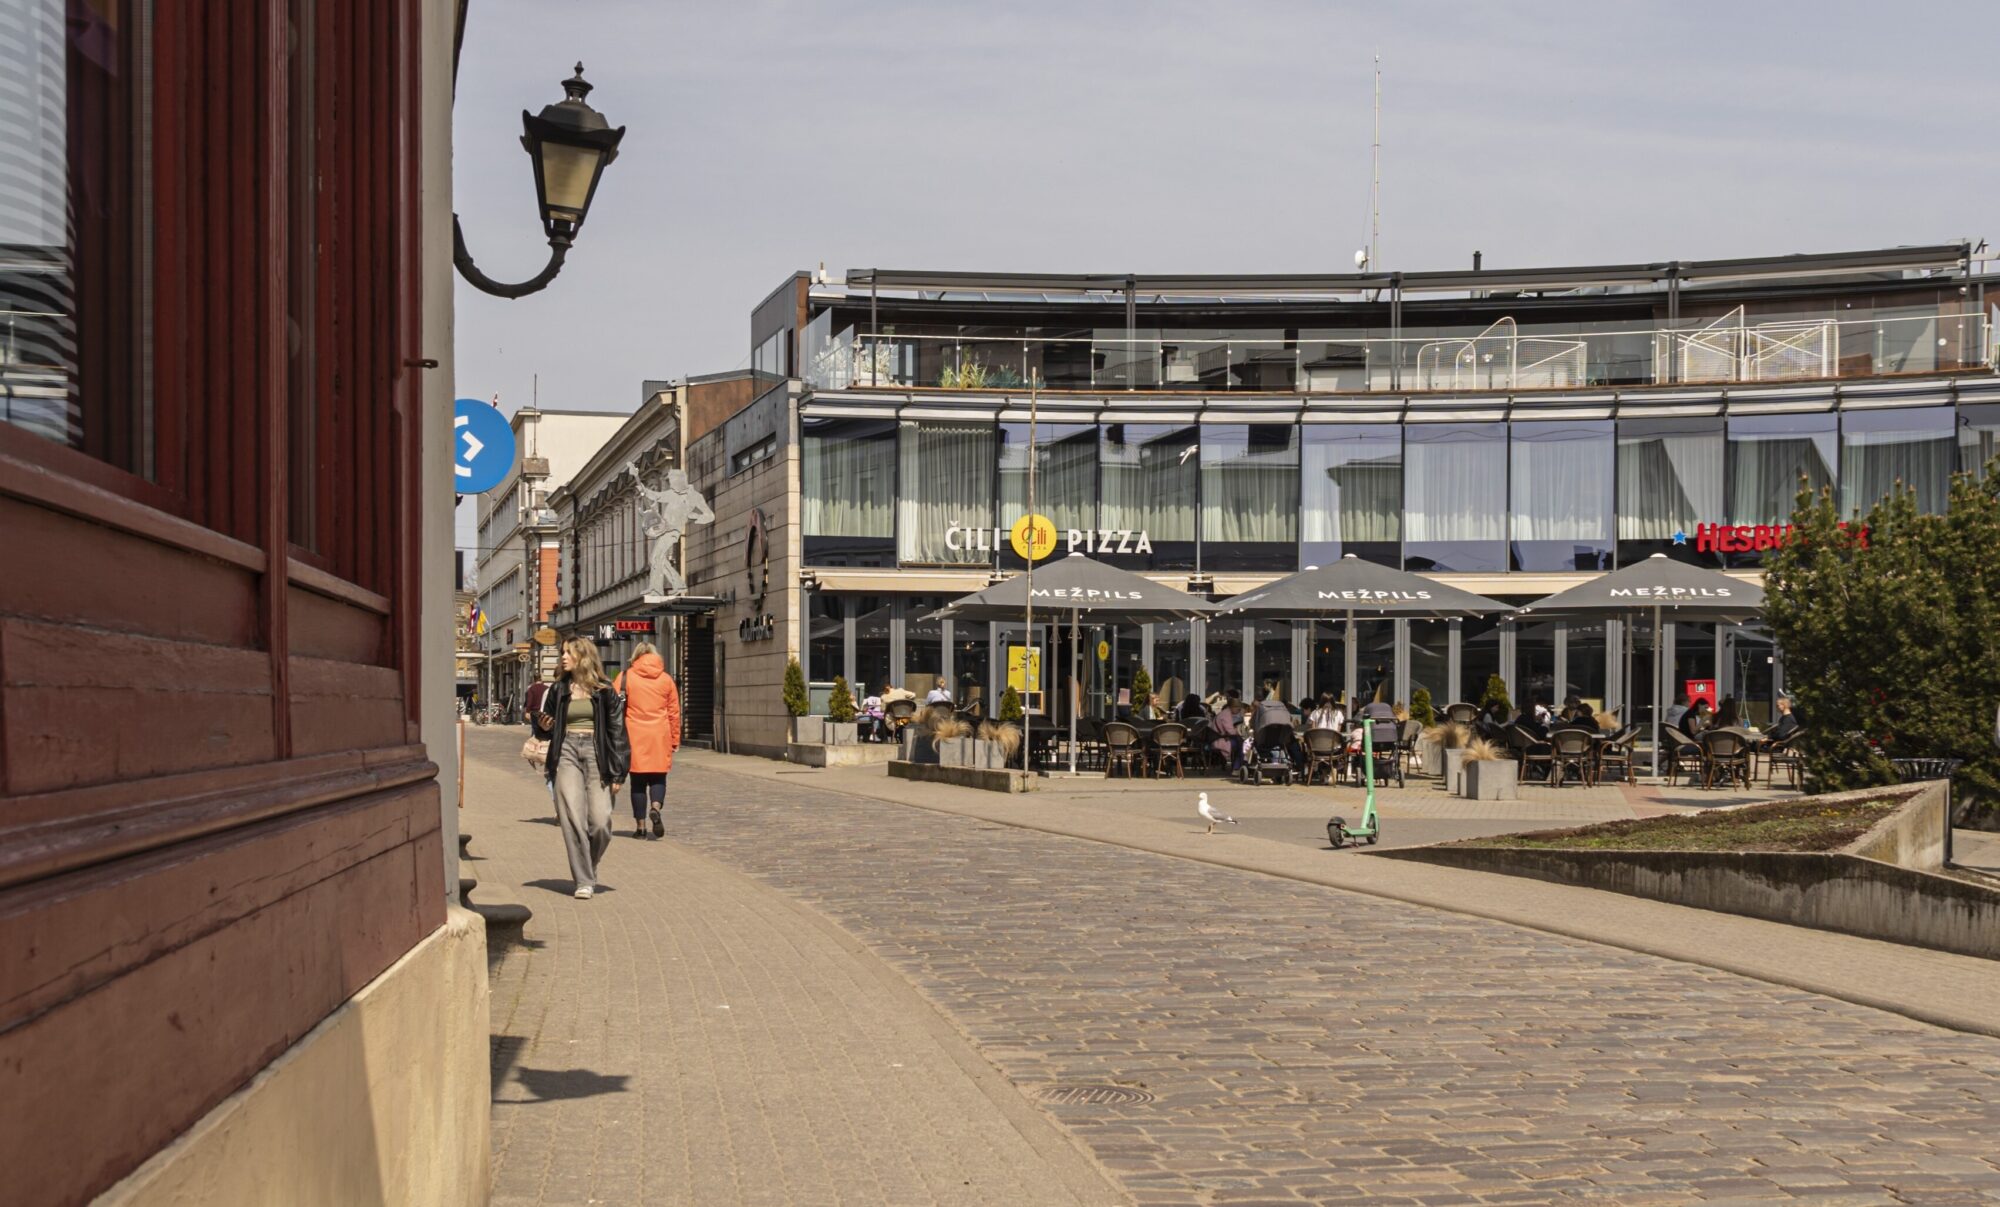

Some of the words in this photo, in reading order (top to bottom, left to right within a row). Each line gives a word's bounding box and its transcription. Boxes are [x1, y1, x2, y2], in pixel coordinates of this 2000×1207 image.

[945, 520, 1000, 551] ČILI
[1067, 528, 1153, 554] PIZZA
[1030, 587, 1143, 600] MEŽPILS
[1318, 589, 1432, 599] MEŽPILS
[1610, 586, 1732, 597] MEŽPILS
